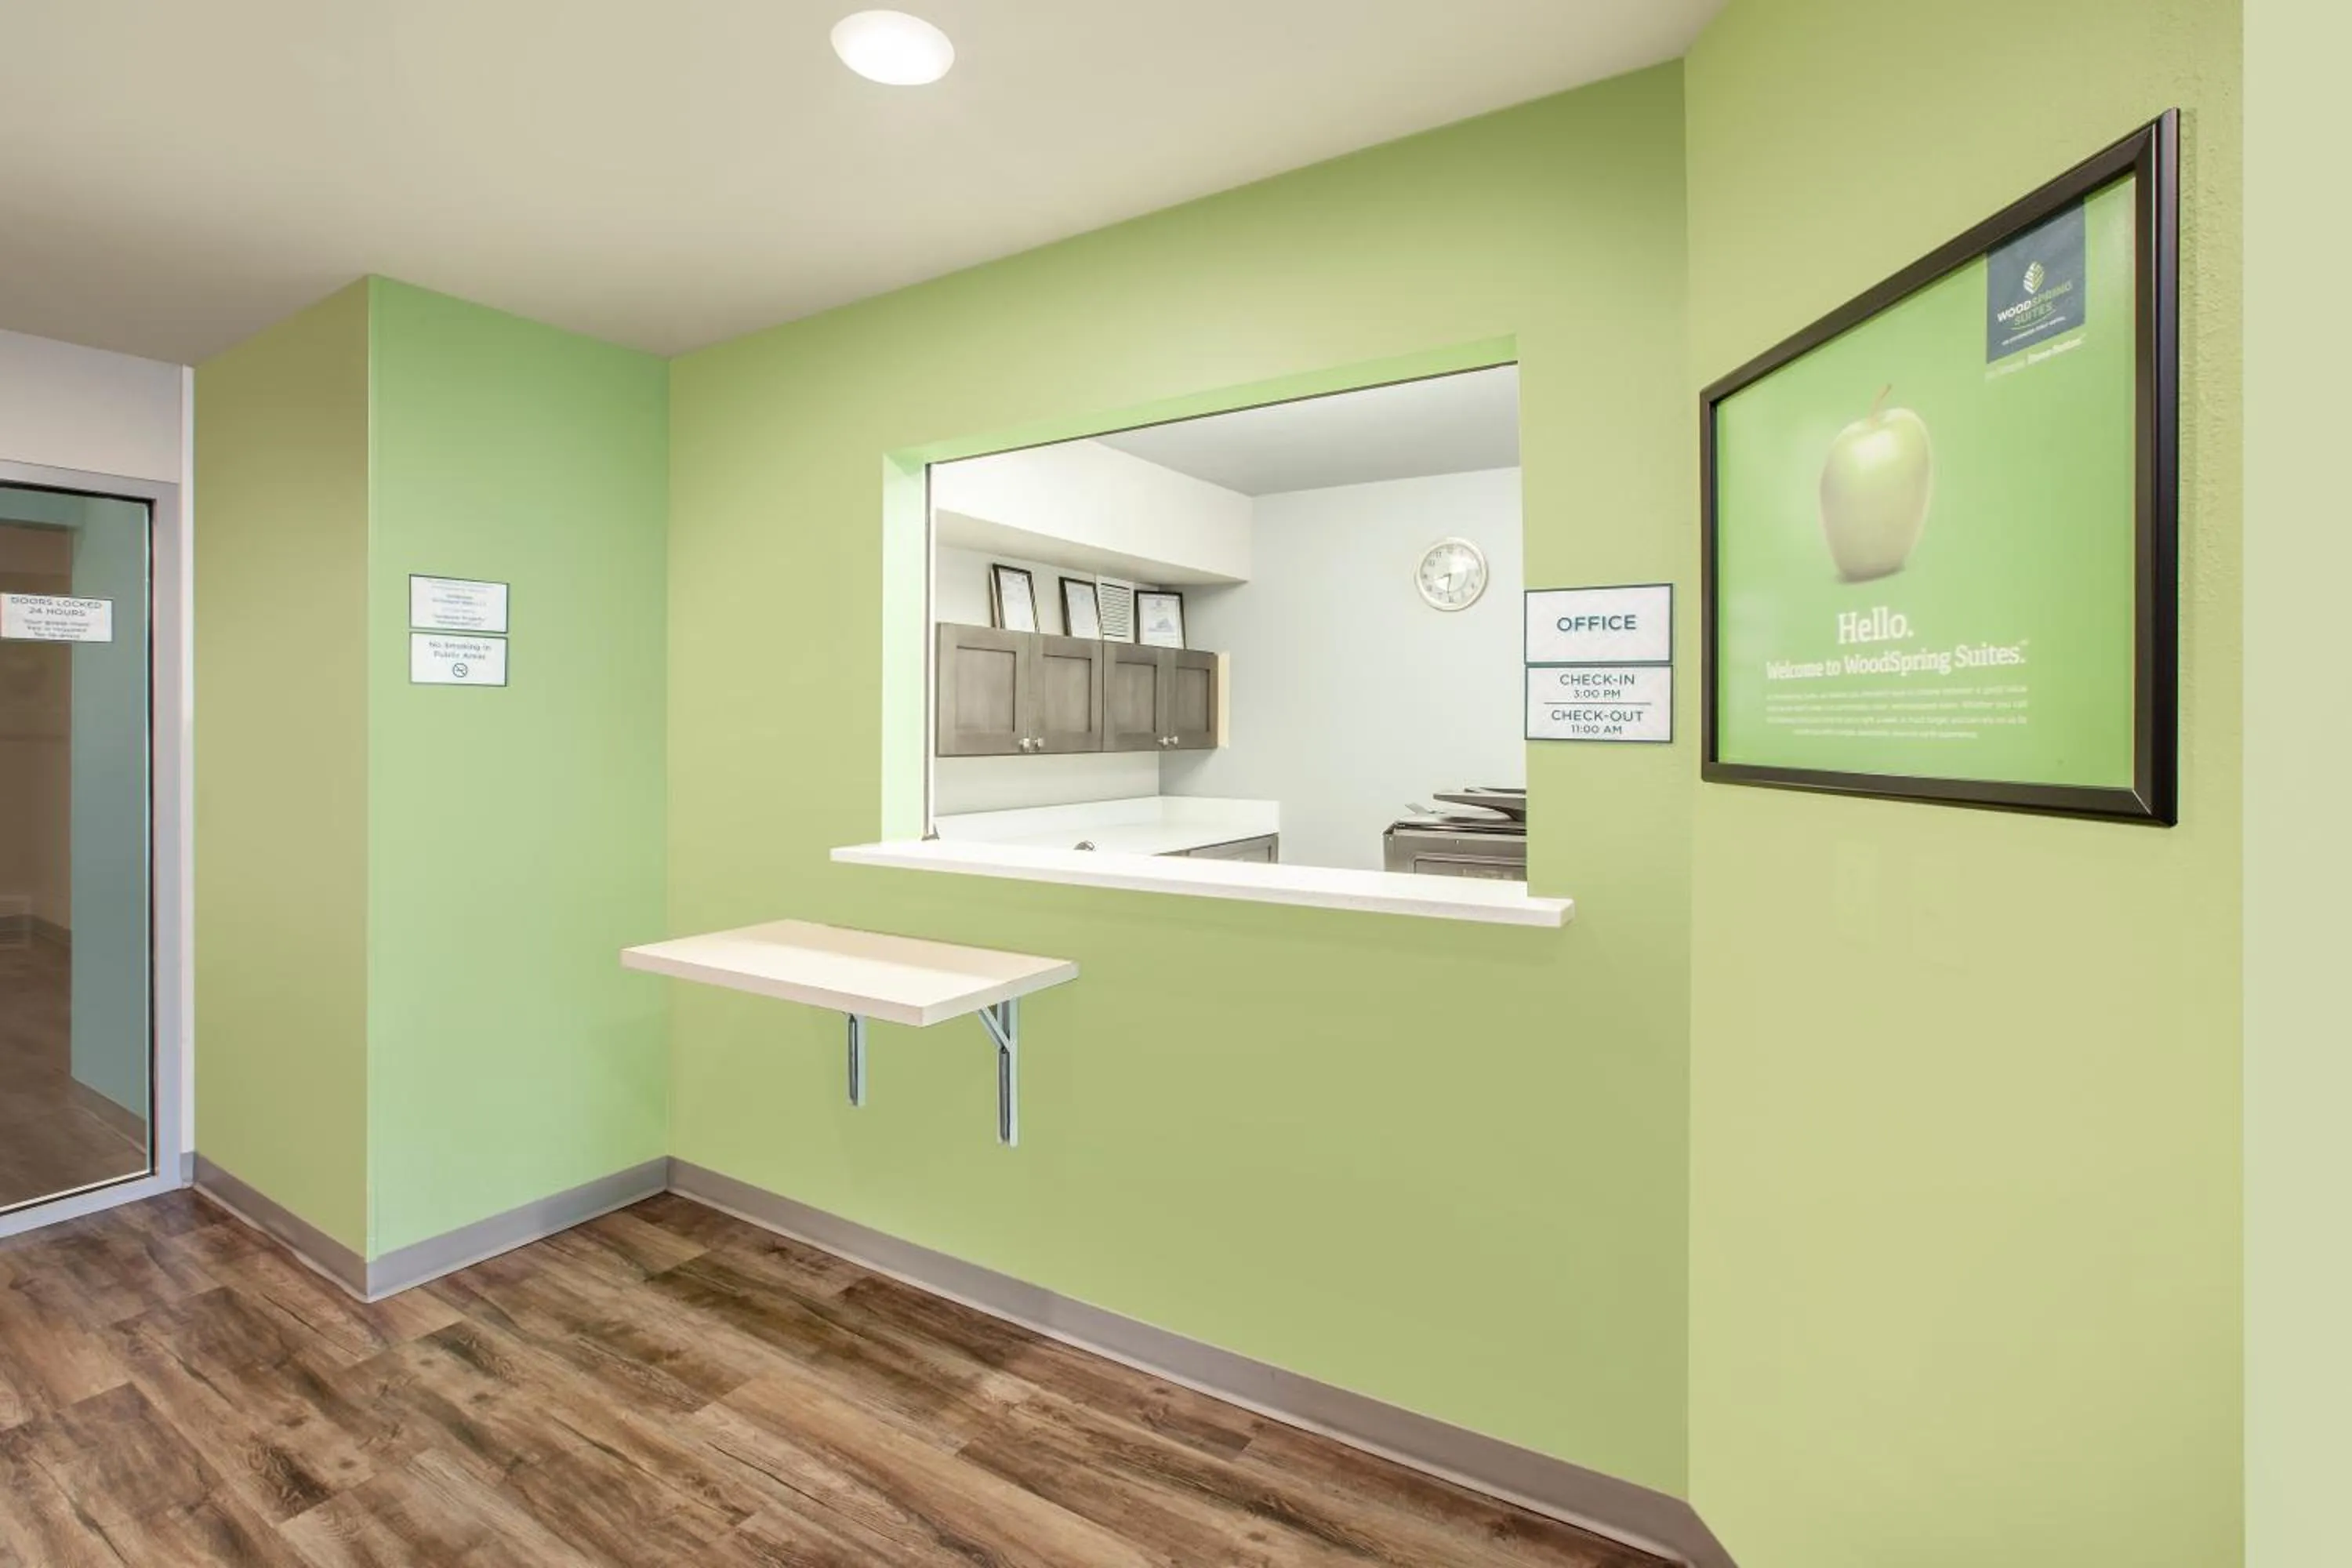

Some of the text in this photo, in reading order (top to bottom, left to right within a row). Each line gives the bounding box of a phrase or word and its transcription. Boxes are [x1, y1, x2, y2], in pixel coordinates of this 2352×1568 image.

[11, 597, 103, 609] DOORS LOCKED
[1556, 615, 1637, 632] OFFICE
[1838, 605, 1914, 644] Hello.
[1766, 659, 1823, 680] Welcome
[1826, 659, 1841, 676] to
[1844, 648, 1951, 677] WoodSpring
[1559, 673, 1635, 686] CHECK-IN
[1573, 689, 1621, 699] 3:00 PM
[1552, 709, 1643, 722] CHECK-OUT
[1571, 724, 1623, 735] 11:00 AM
